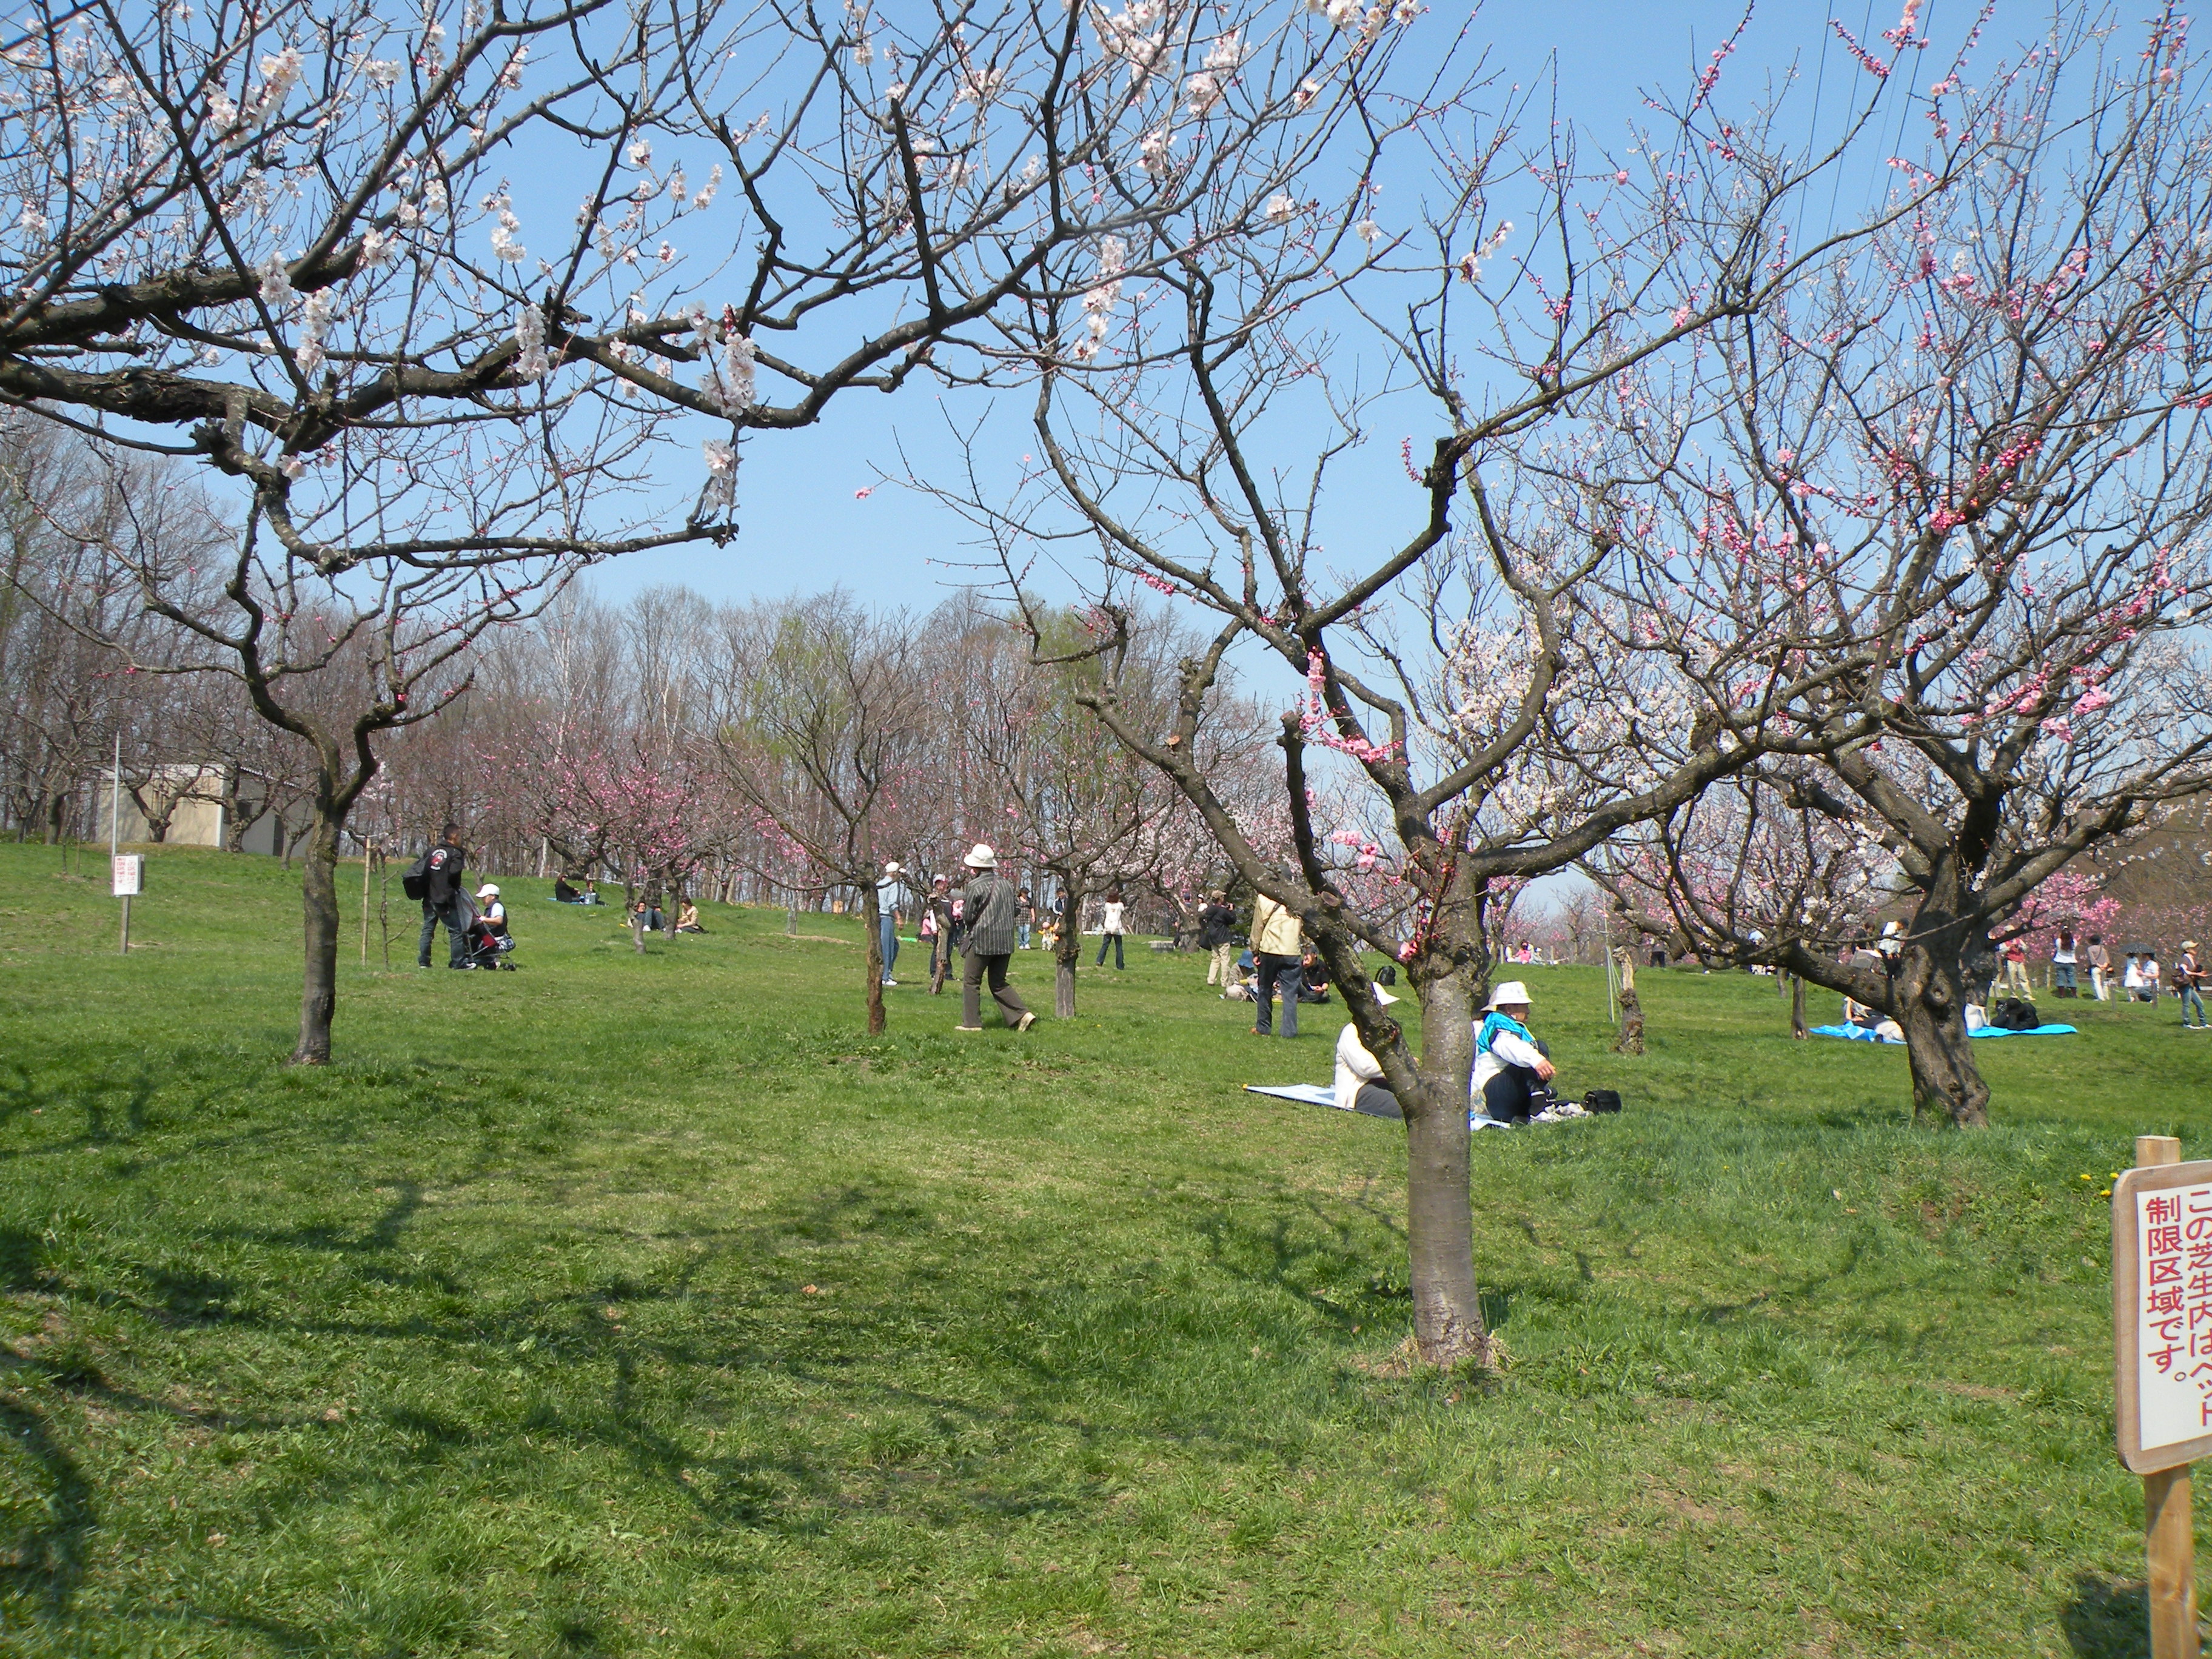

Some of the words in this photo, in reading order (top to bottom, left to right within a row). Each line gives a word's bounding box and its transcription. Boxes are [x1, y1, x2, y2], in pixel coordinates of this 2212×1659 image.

[2146, 1195, 2186, 1382] 制限区域です。
